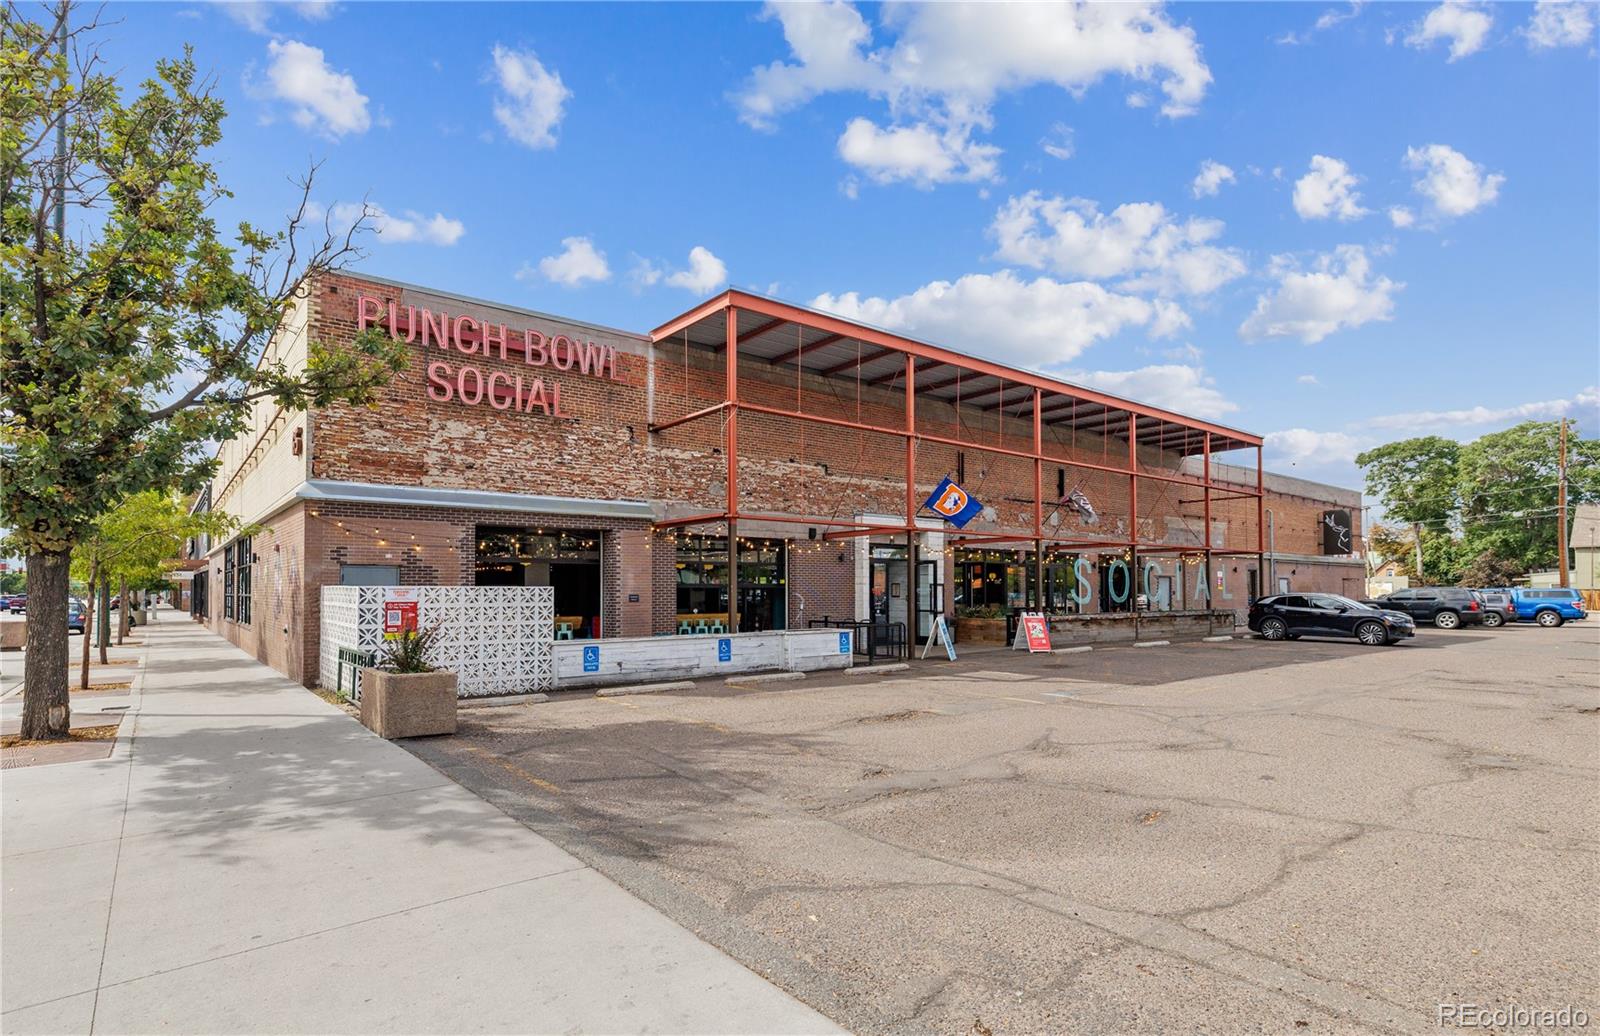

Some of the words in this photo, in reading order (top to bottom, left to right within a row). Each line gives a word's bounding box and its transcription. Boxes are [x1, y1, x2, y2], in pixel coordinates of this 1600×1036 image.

[358, 294, 508, 361] PUNCH
[525, 328, 627, 382] BOWL
[427, 361, 572, 419] SOCIAL
[1072, 557, 1233, 606] SOCIAL
